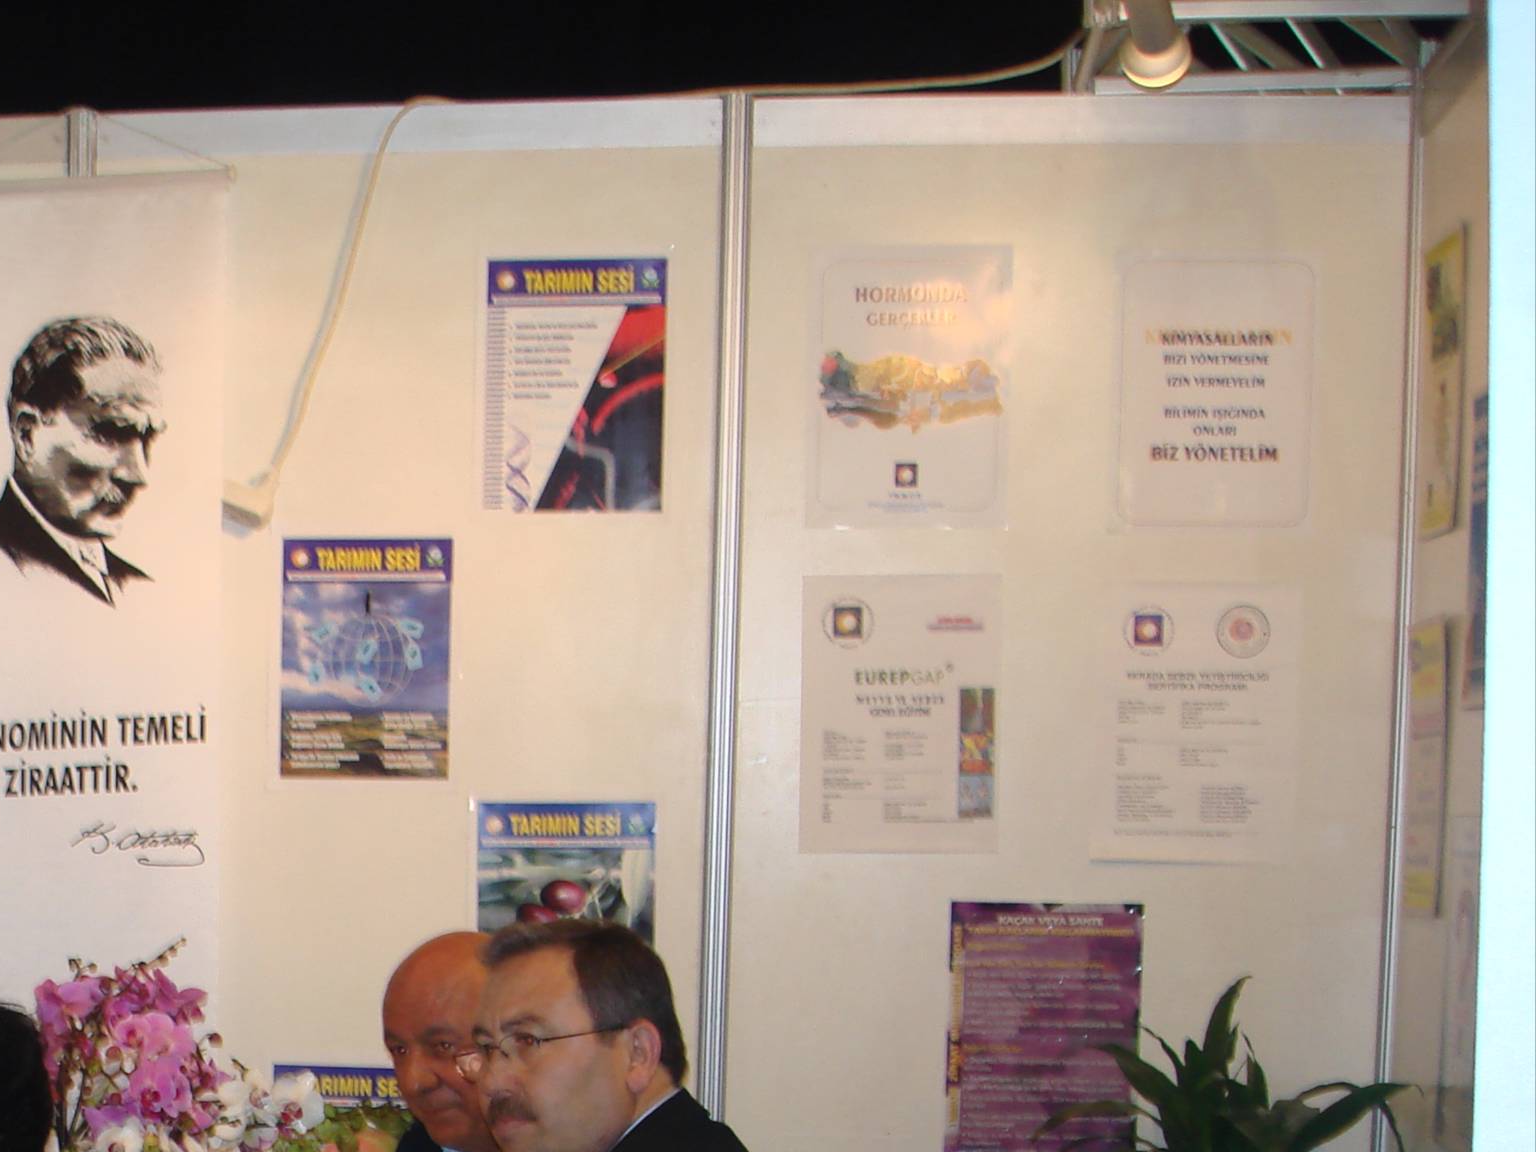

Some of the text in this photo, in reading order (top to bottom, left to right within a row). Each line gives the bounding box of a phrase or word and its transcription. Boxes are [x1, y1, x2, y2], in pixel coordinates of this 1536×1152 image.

[522, 264, 635, 295] TARIMIN SESİ
[1193, 425, 1237, 437] ONLARI
[1150, 443, 1279, 463] BİZ YÖNETELİM
[315, 542, 421, 572] TARIMIN SESİ
[116, 704, 208, 746] TEMELİ
[3, 755, 139, 798] ZİRAATTİR.
[509, 810, 622, 837] TARIMIN SESİ
